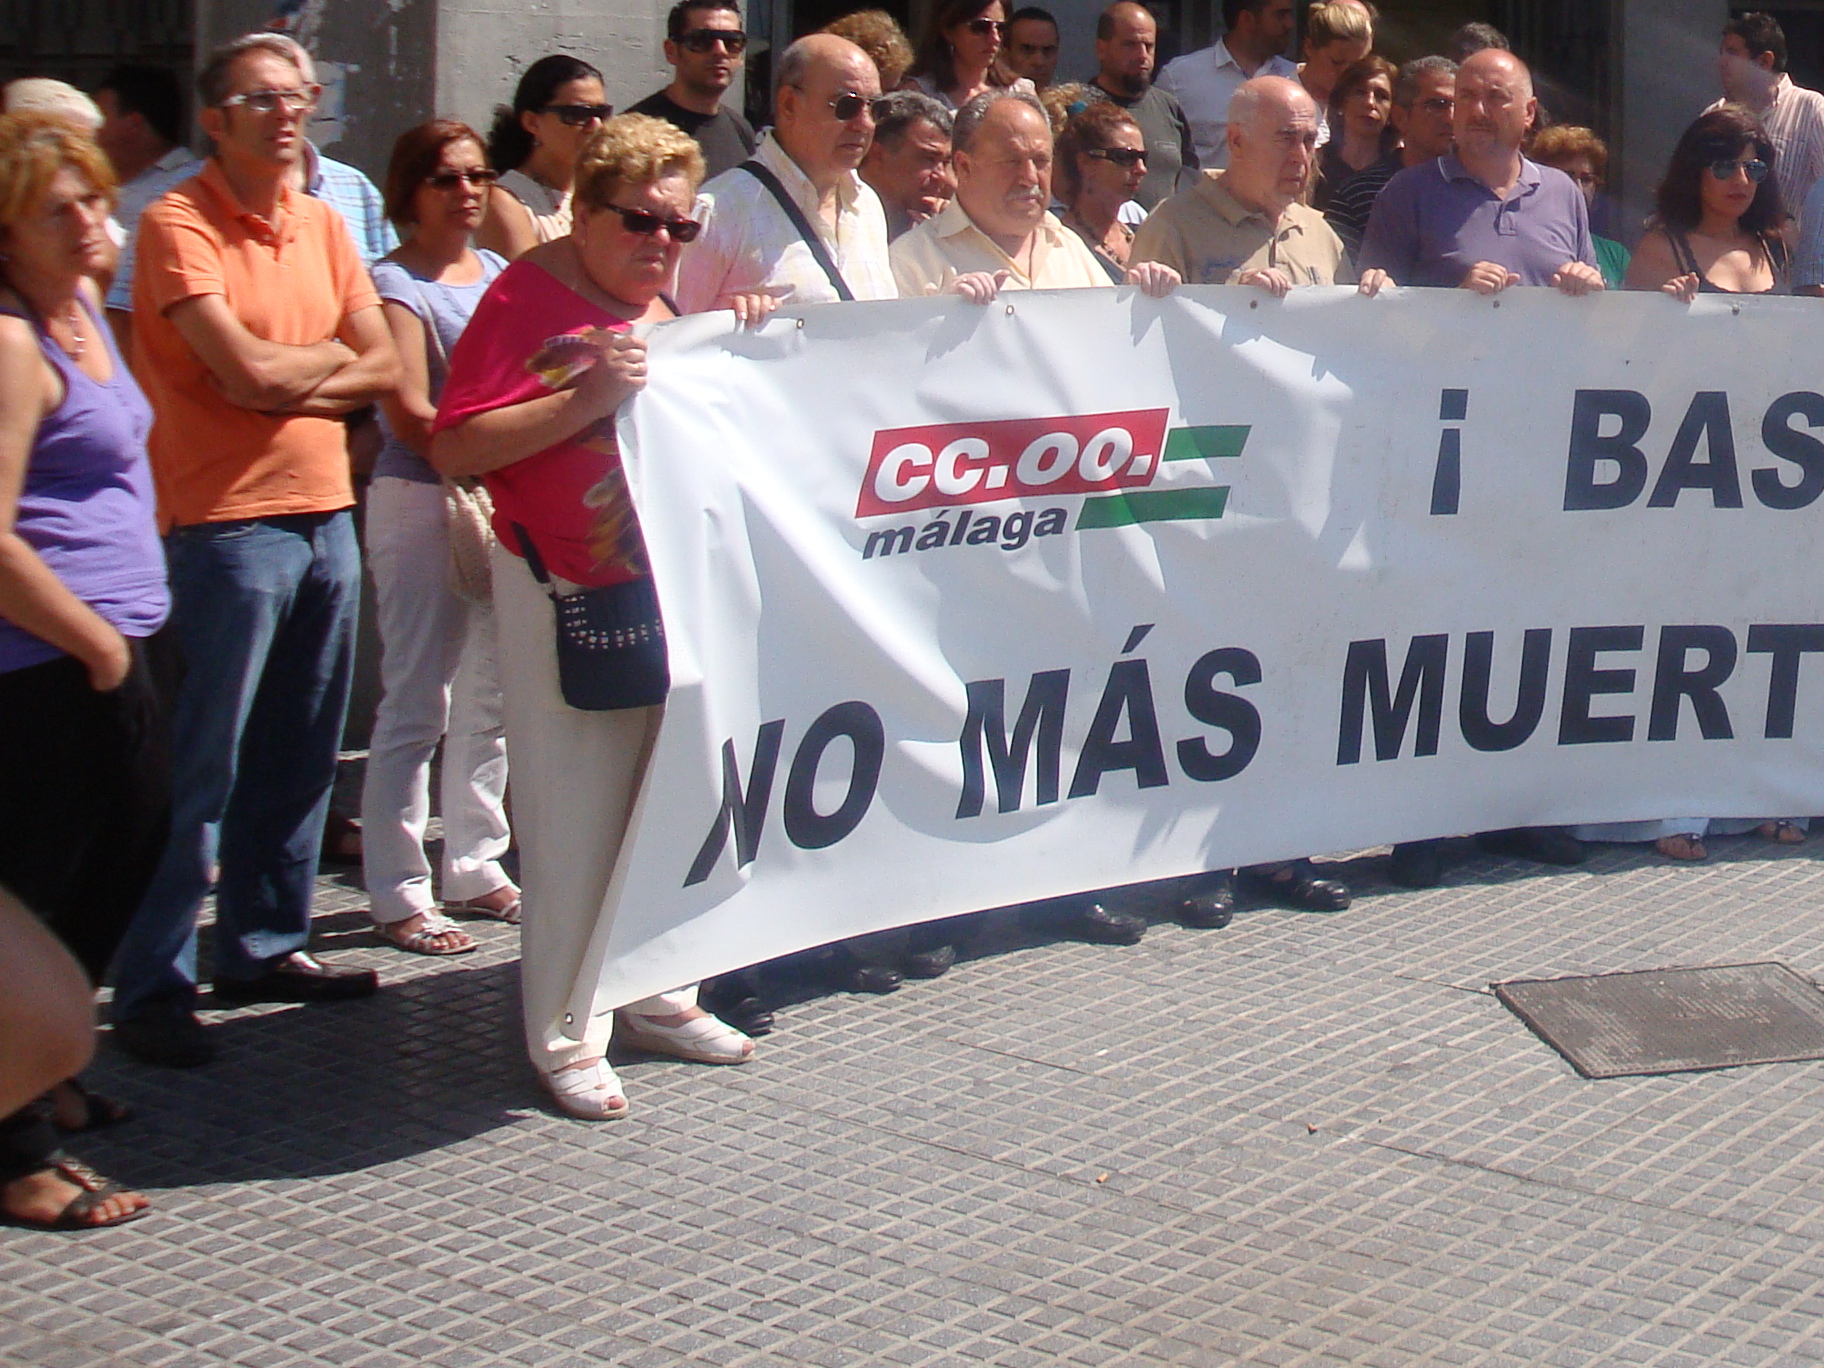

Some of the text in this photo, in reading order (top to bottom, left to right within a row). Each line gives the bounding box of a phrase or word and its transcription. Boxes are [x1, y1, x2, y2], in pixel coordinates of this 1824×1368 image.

[874, 426, 1154, 503] CC.OO.
[862, 505, 1068, 561] málaga
[682, 699, 885, 888] NO
[953, 622, 1263, 820] MÁS
